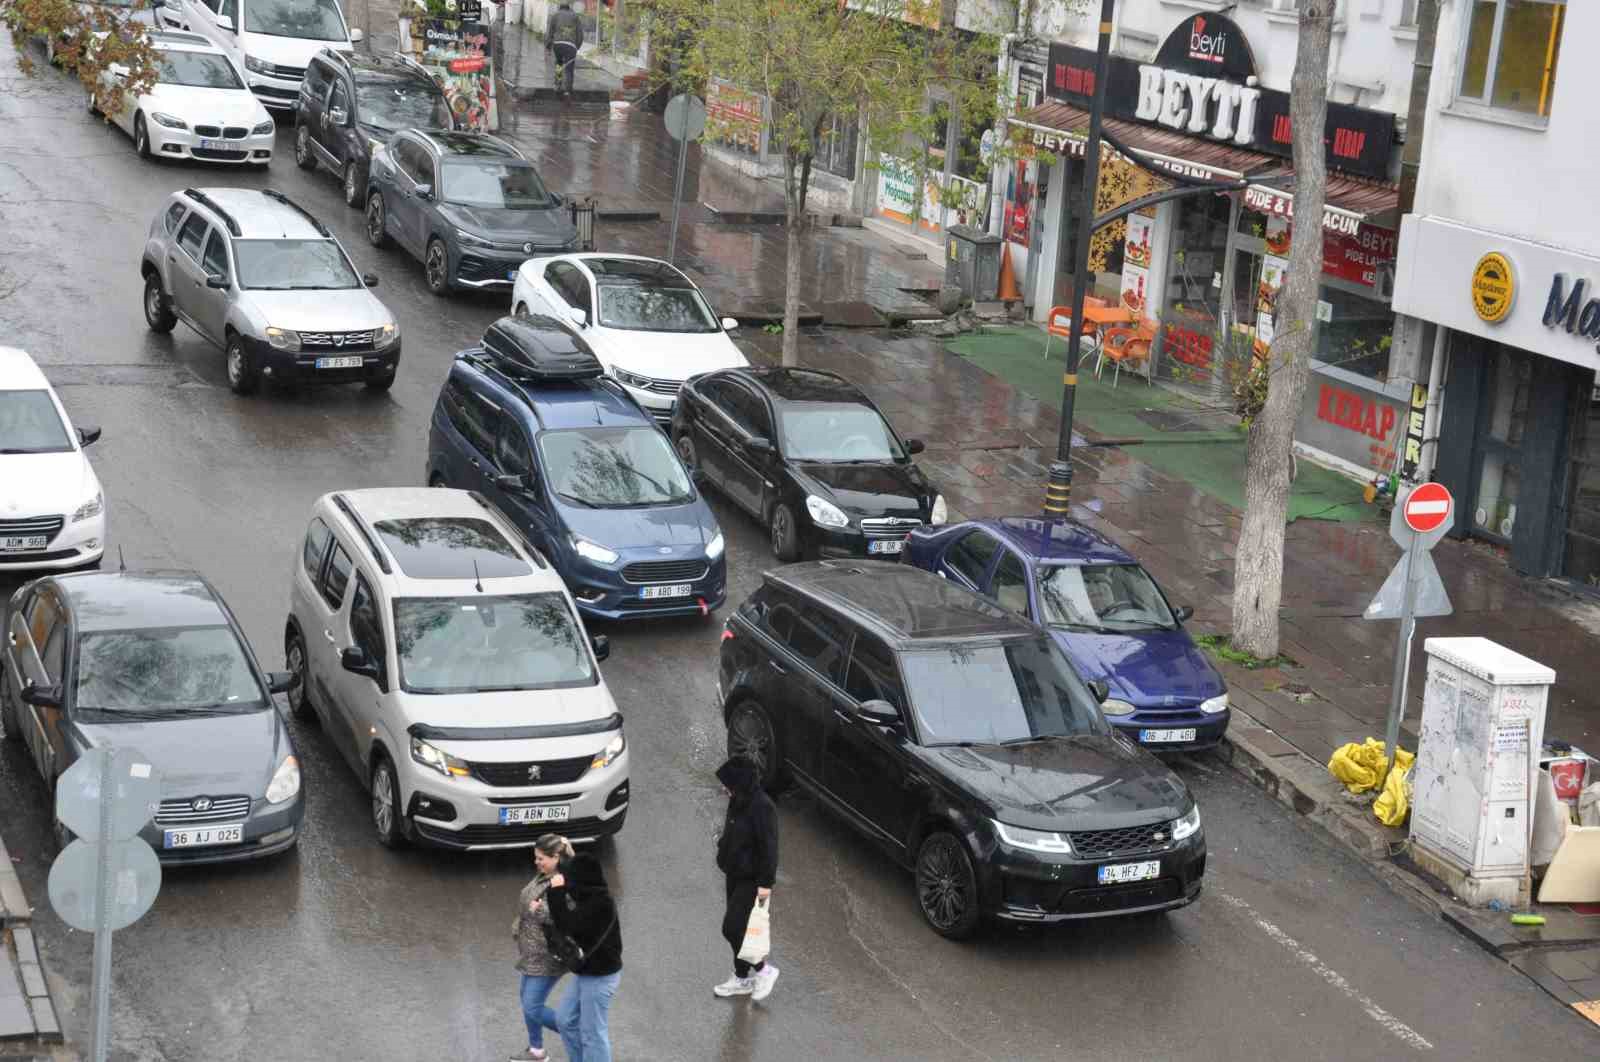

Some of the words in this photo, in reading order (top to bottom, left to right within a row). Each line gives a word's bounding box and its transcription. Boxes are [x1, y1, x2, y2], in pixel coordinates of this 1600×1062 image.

[1190, 20, 1226, 56] beyti
[1274, 197, 1285, 213] &
[1362, 231, 1393, 253] BEYT
[1542, 272, 1600, 345] Ma
[1317, 383, 1395, 441] KEBAP
[509, 808, 520, 820] 36
[523, 807, 544, 820] ABN
[547, 806, 567, 819] 064
[174, 833, 188, 845] 36
[195, 831, 210, 843] AJ
[217, 829, 240, 842] 025
[1105, 867, 1116, 880] 34
[1121, 865, 1139, 878] HFZ
